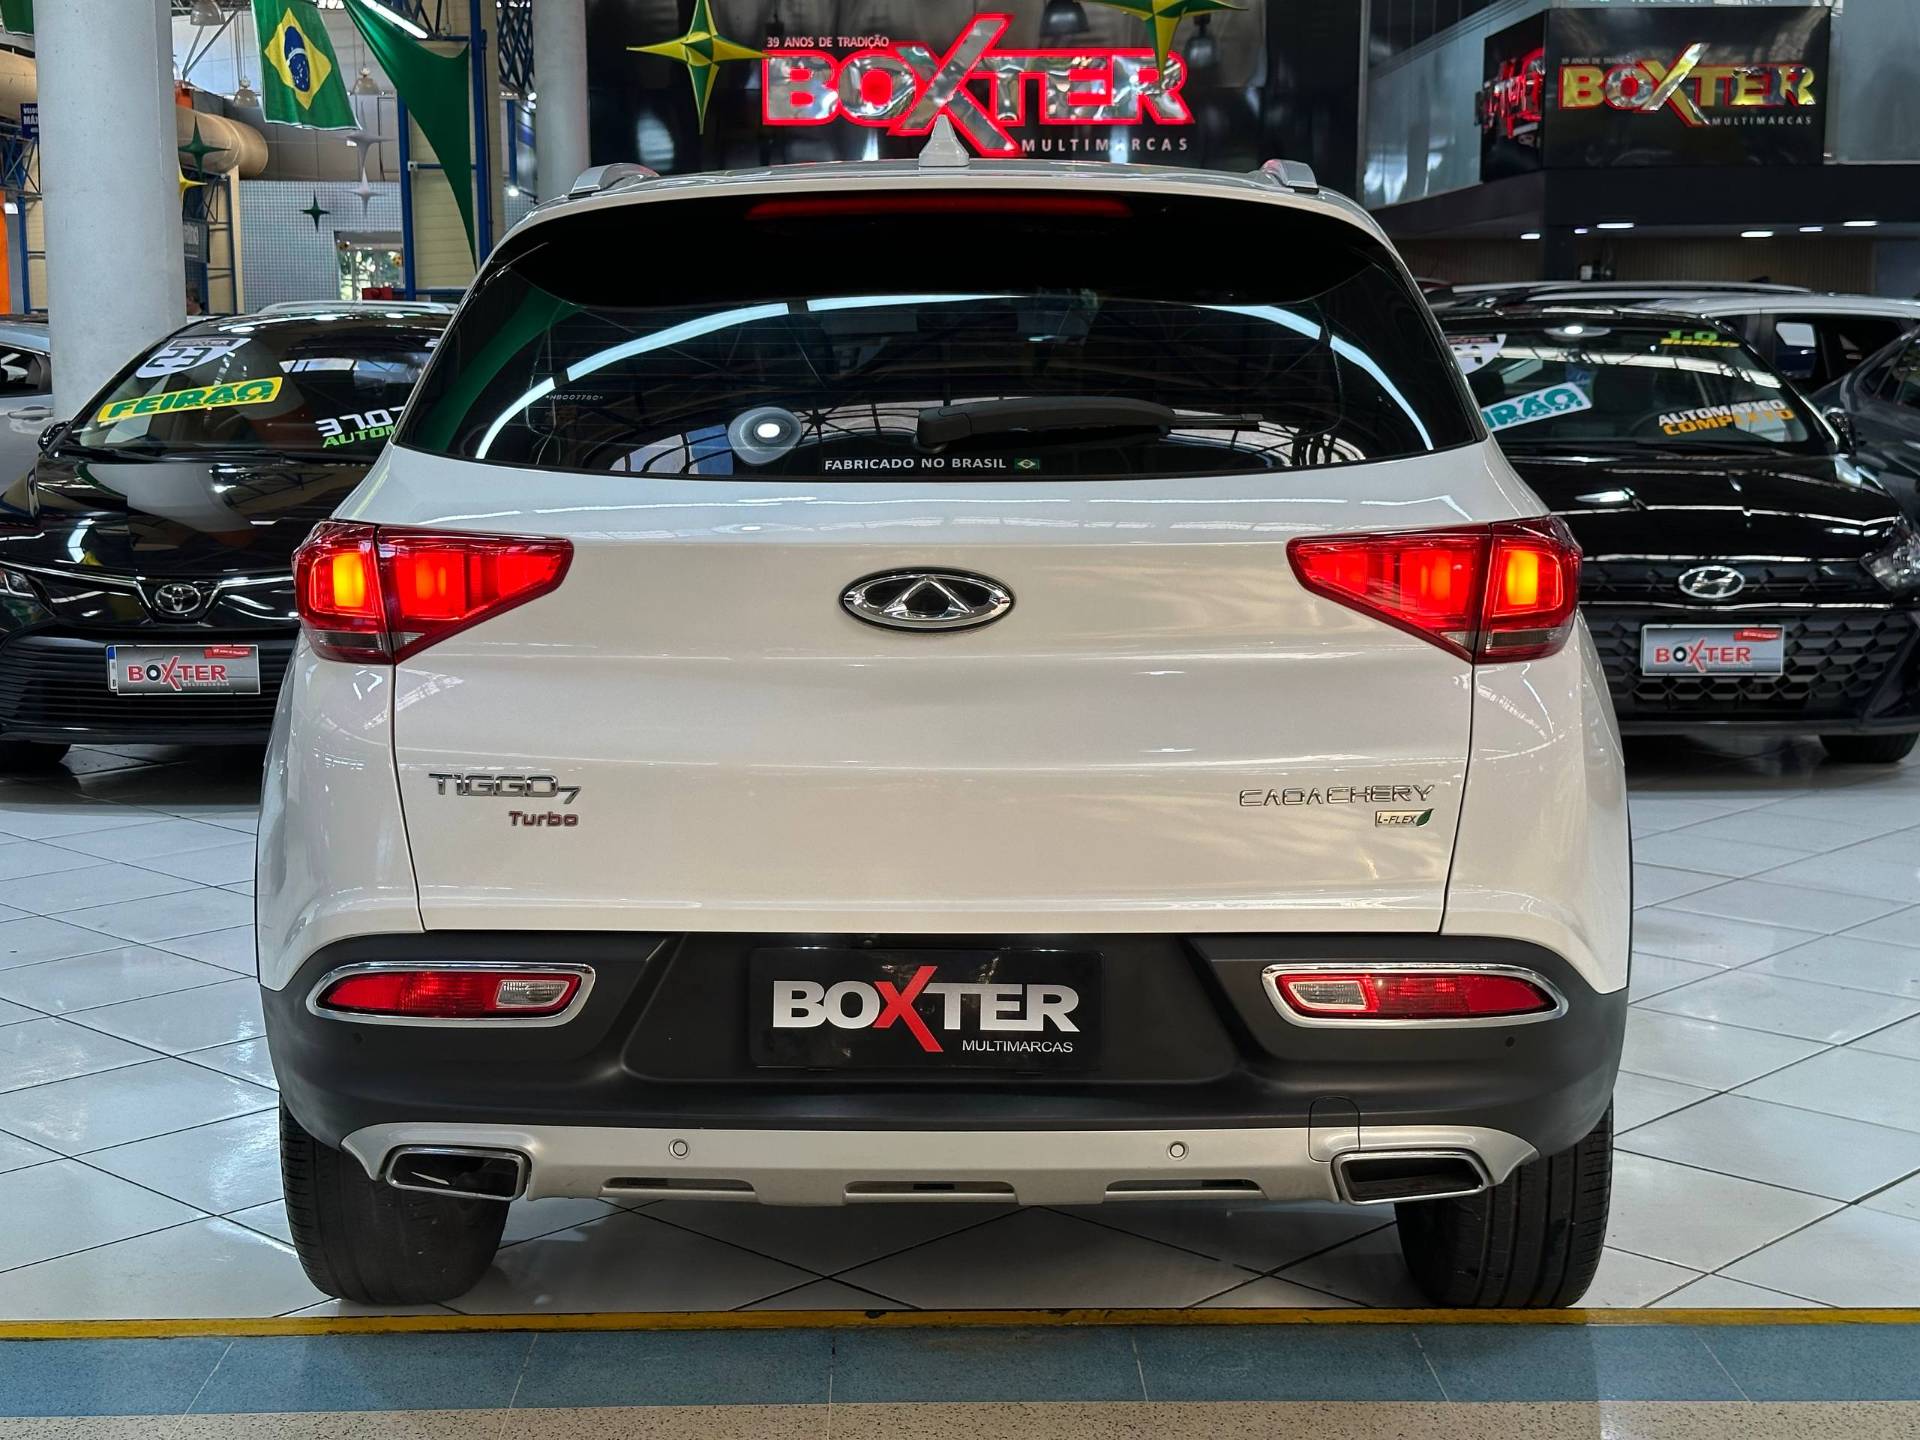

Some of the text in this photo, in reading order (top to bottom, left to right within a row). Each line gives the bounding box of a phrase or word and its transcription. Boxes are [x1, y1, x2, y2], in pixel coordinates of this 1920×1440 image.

[767, 35, 889, 49] 39 ANOS DE TRADIÇÃO
[762, 12, 1195, 157] BOXTER
[1558, 42, 1817, 127] BOXTER
[1712, 116, 1812, 126] MULTIMARCAS
[1021, 138, 1188, 152] MULTIMARCAS
[108, 380, 276, 418] FEIRÃO
[824, 457, 1007, 471] FABRICADO NO BRASIL
[1654, 636, 1753, 673] BOXTER
[127, 655, 230, 691] BOXTER
[508, 810, 579, 827] Turbo
[1376, 813, 1418, 826] L-FLEX
[772, 965, 1081, 1053] BOXTER
[961, 1039, 1074, 1054] MULTIMARCAS
